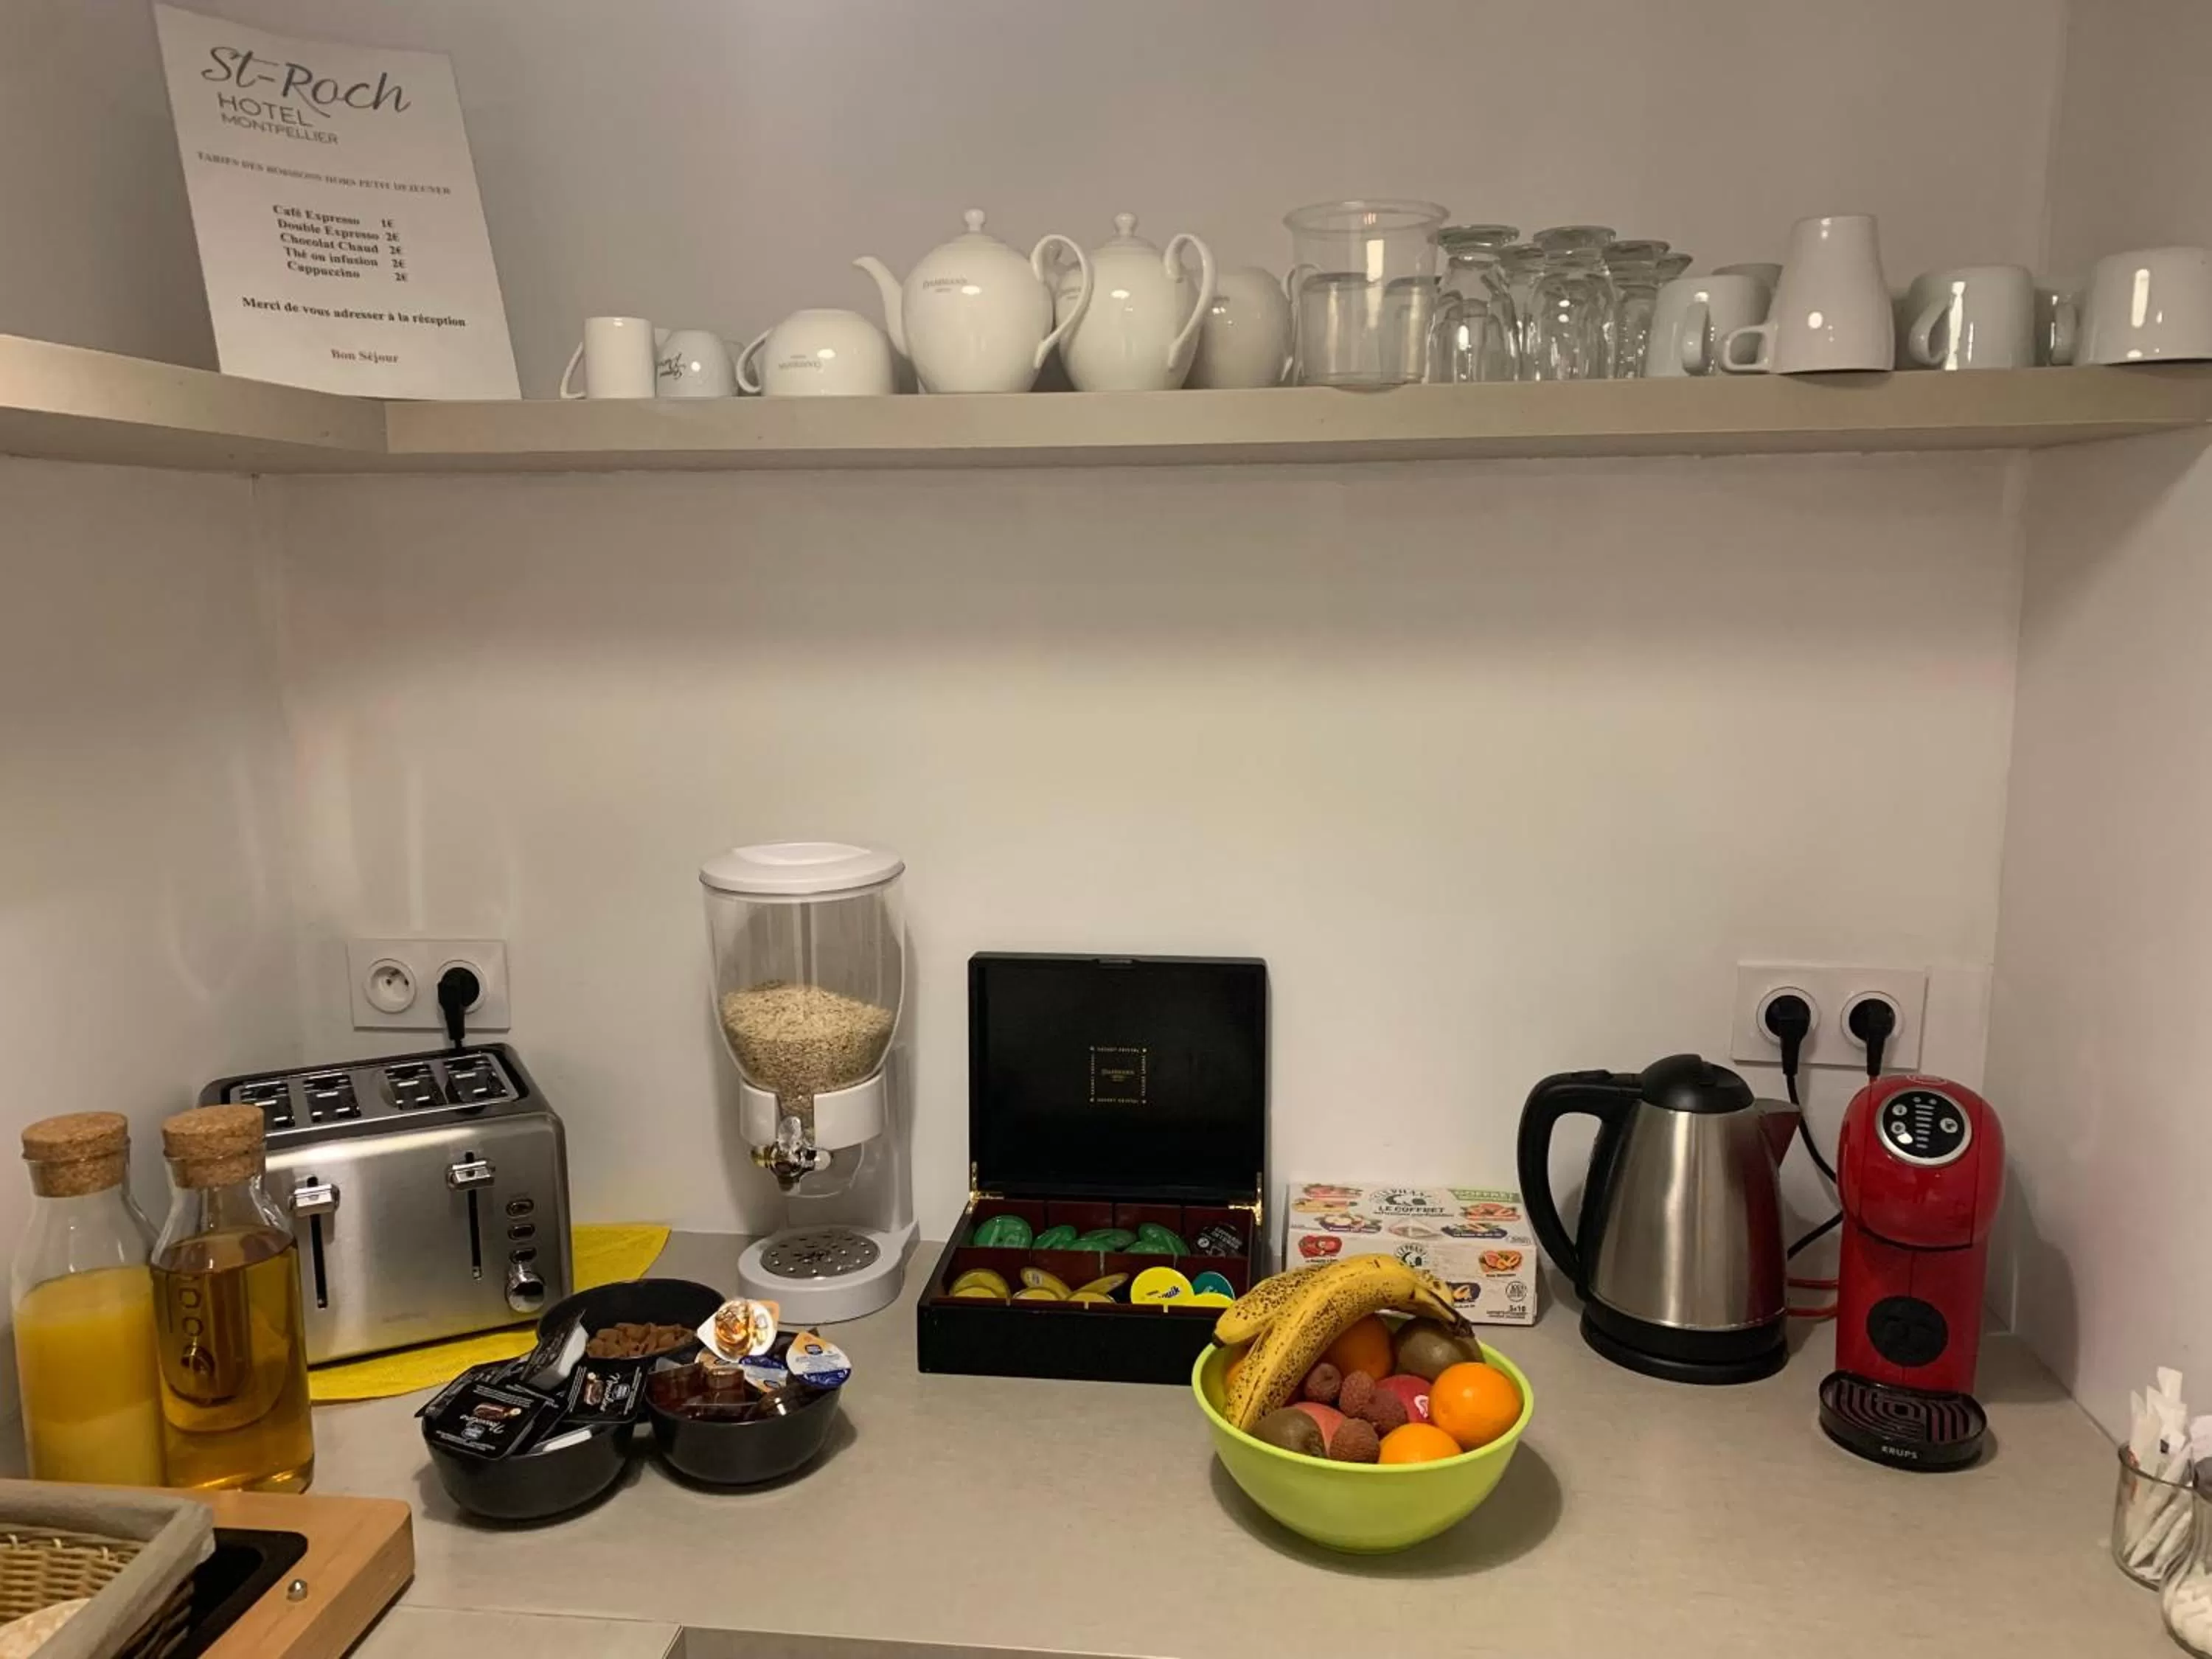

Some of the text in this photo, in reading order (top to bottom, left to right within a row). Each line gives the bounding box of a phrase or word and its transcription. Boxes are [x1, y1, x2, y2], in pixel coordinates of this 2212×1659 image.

[201, 46, 412, 118] St-Roch
[217, 91, 313, 127] HOTEL
[220, 112, 338, 145] MONTPELLIER
[272, 204, 302, 218] Café
[305, 209, 361, 224] Expresso
[277, 218, 400, 242] Double Expresso 2€
[279, 232, 403, 255] Chocolat Chaud 2€
[287, 260, 361, 278] Cappuccino
[310, 252, 326, 262] ou
[329, 253, 378, 266] infusion
[392, 258, 406, 268] 2€
[242, 296, 466, 327] Merci de vous adresser à la réception
[331, 348, 399, 364] Bon Séjour
[1881, 1446, 1918, 1459] KRUPS
